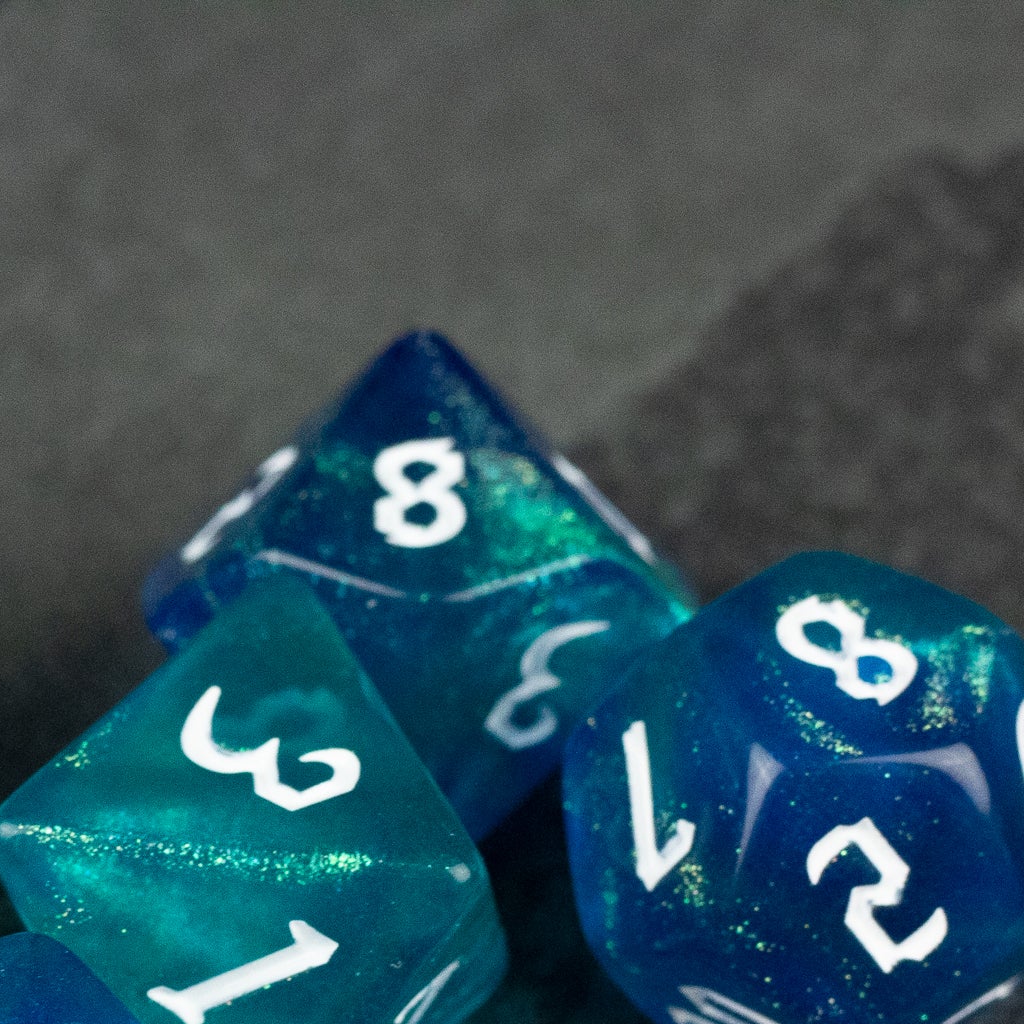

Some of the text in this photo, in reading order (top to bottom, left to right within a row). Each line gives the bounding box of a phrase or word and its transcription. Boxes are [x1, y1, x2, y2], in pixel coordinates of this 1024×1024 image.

[373, 436, 467, 549] 8
[775, 594, 919, 708] 8
[180, 685, 362, 813] 3
[806, 815, 950, 975] 2
